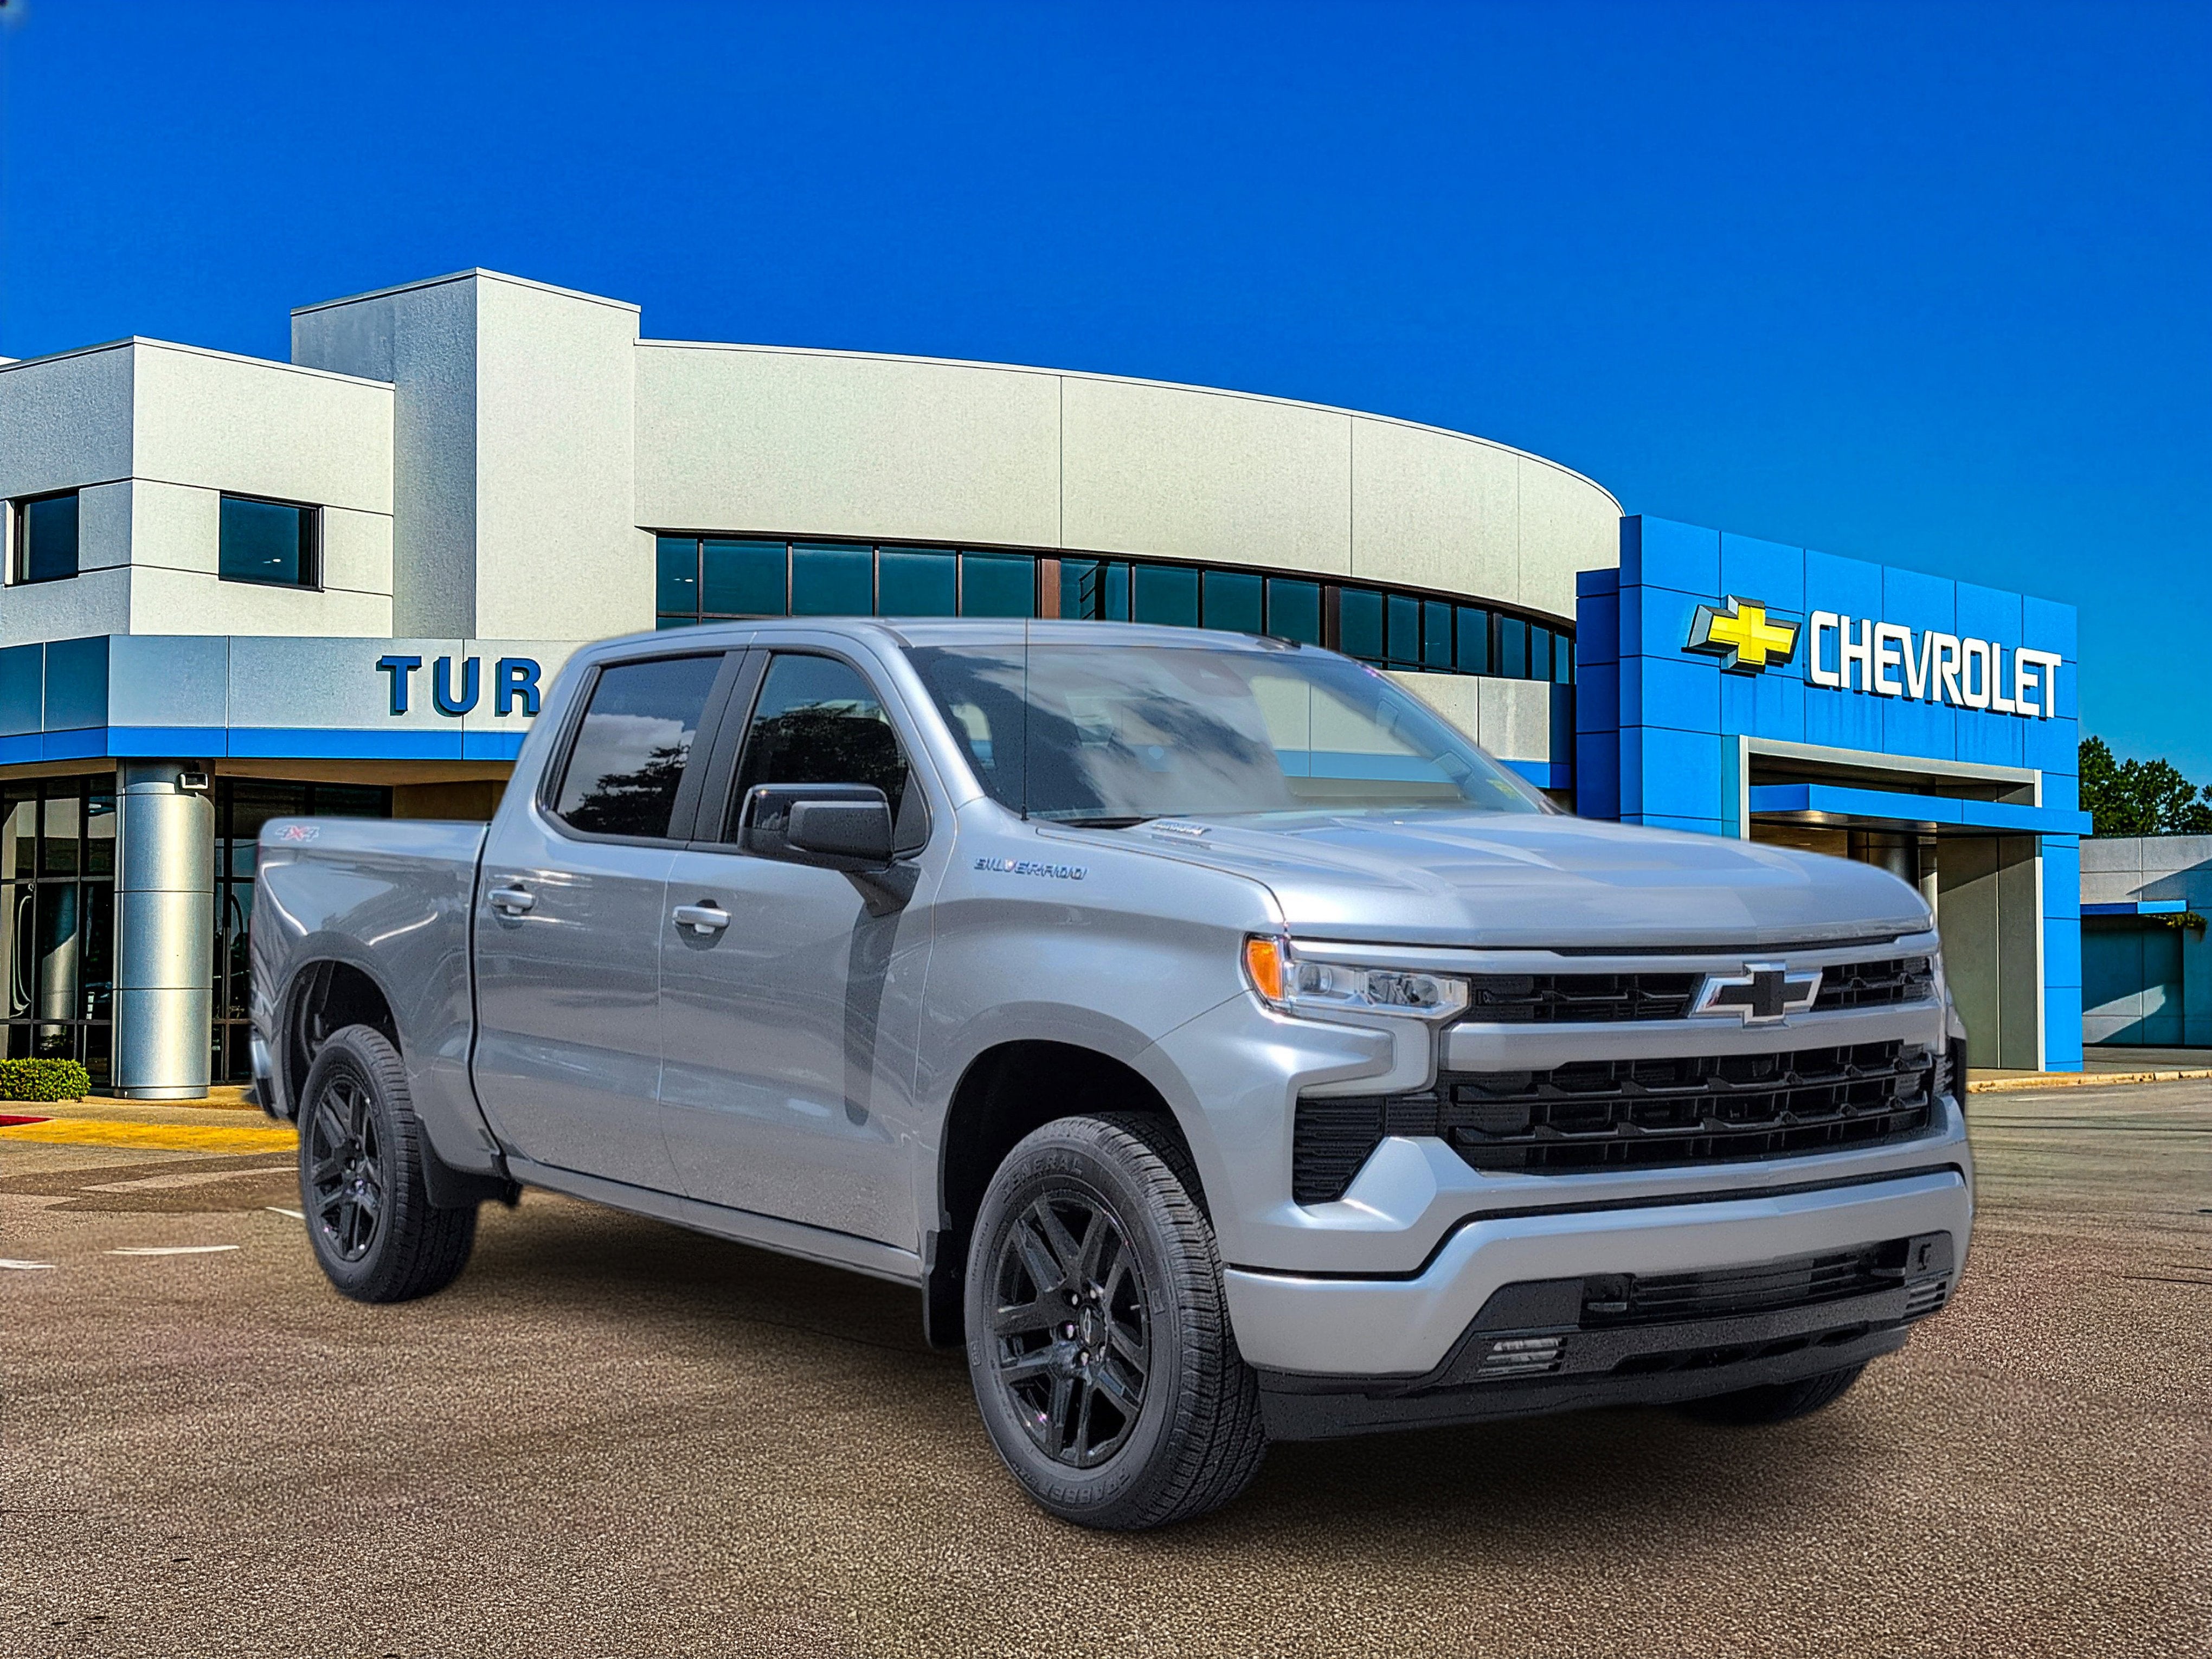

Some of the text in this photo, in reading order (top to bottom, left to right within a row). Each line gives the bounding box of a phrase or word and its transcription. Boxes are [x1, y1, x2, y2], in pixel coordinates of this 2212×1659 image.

[375, 655, 541, 717] TUR
[1810, 610, 2061, 718] CHEVROLET
[974, 858, 1088, 880] SILVERADO
